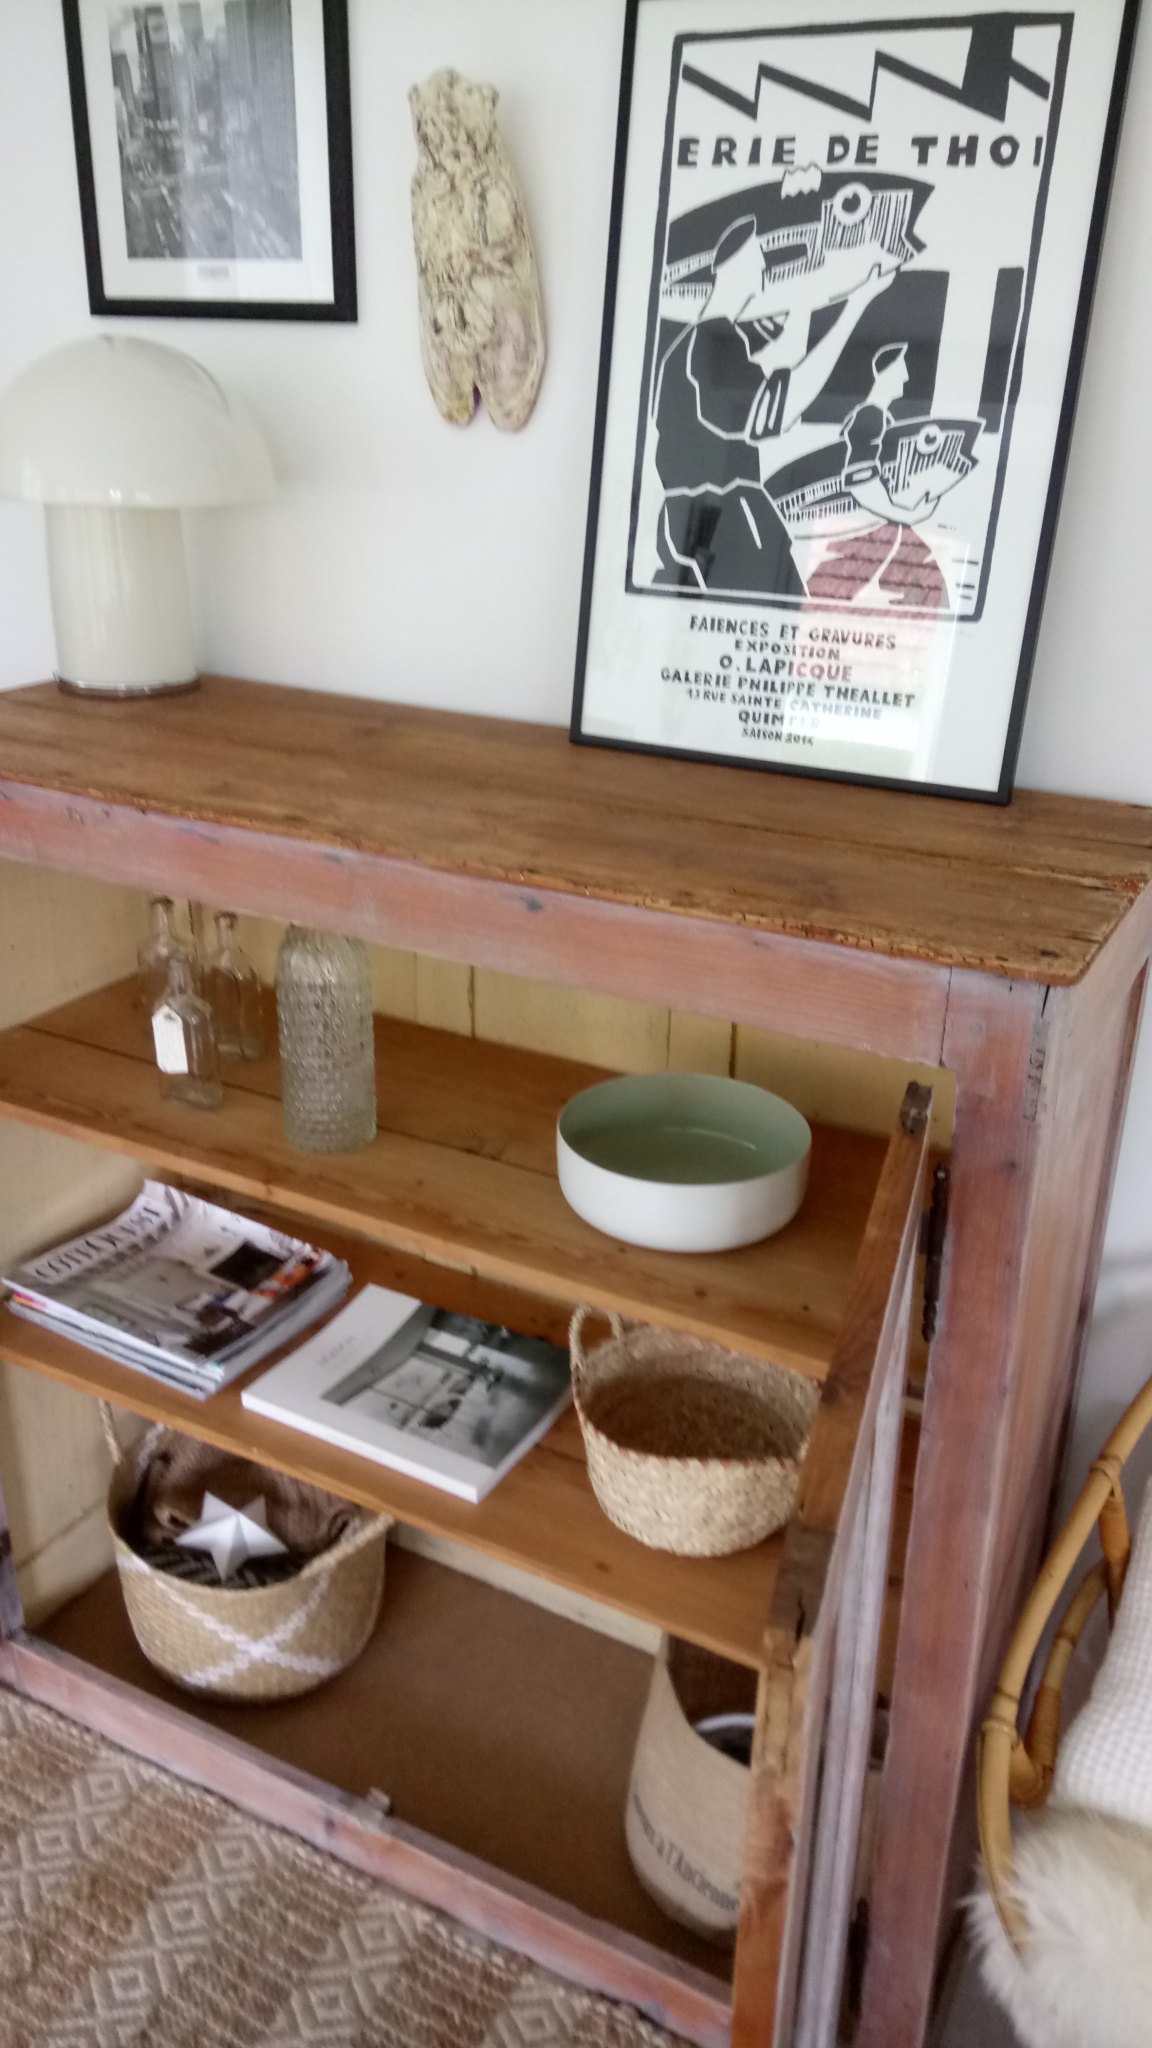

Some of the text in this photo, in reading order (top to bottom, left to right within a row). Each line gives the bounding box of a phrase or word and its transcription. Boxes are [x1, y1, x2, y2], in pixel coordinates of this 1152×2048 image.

[677, 136, 796, 167] ERIE
[826, 134, 879, 166] DE
[689, 614, 896, 650] FAIENCES ET GRAVURES
[734, 639, 840, 661] EXPOSITION
[661, 667, 731, 688] GALERIE
[824, 685, 915, 708] THEALLET
[731, 693, 781, 710] SAINTE
